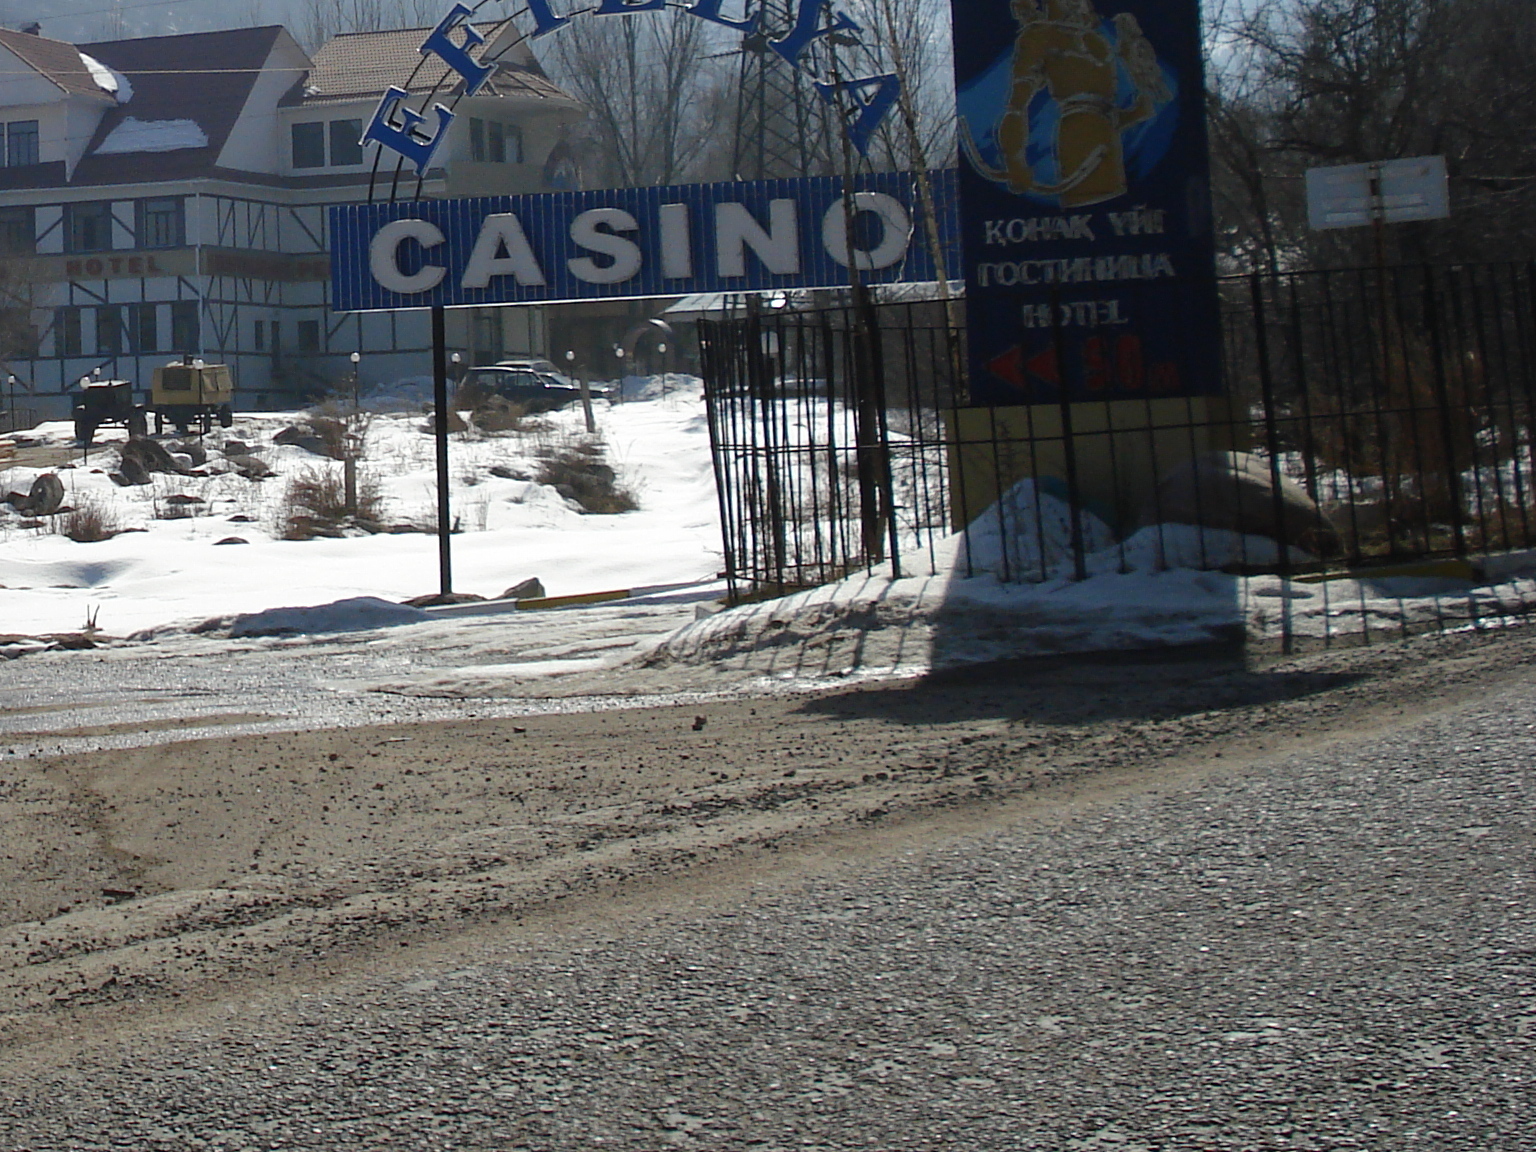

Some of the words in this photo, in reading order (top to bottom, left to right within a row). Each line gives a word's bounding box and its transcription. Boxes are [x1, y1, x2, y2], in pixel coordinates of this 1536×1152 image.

[369, 191, 912, 295] CASINO
[66, 254, 163, 278] HOTEL
[977, 252, 1177, 287] ГОСТИНИЦА
[1022, 299, 1129, 329] HOTEL
